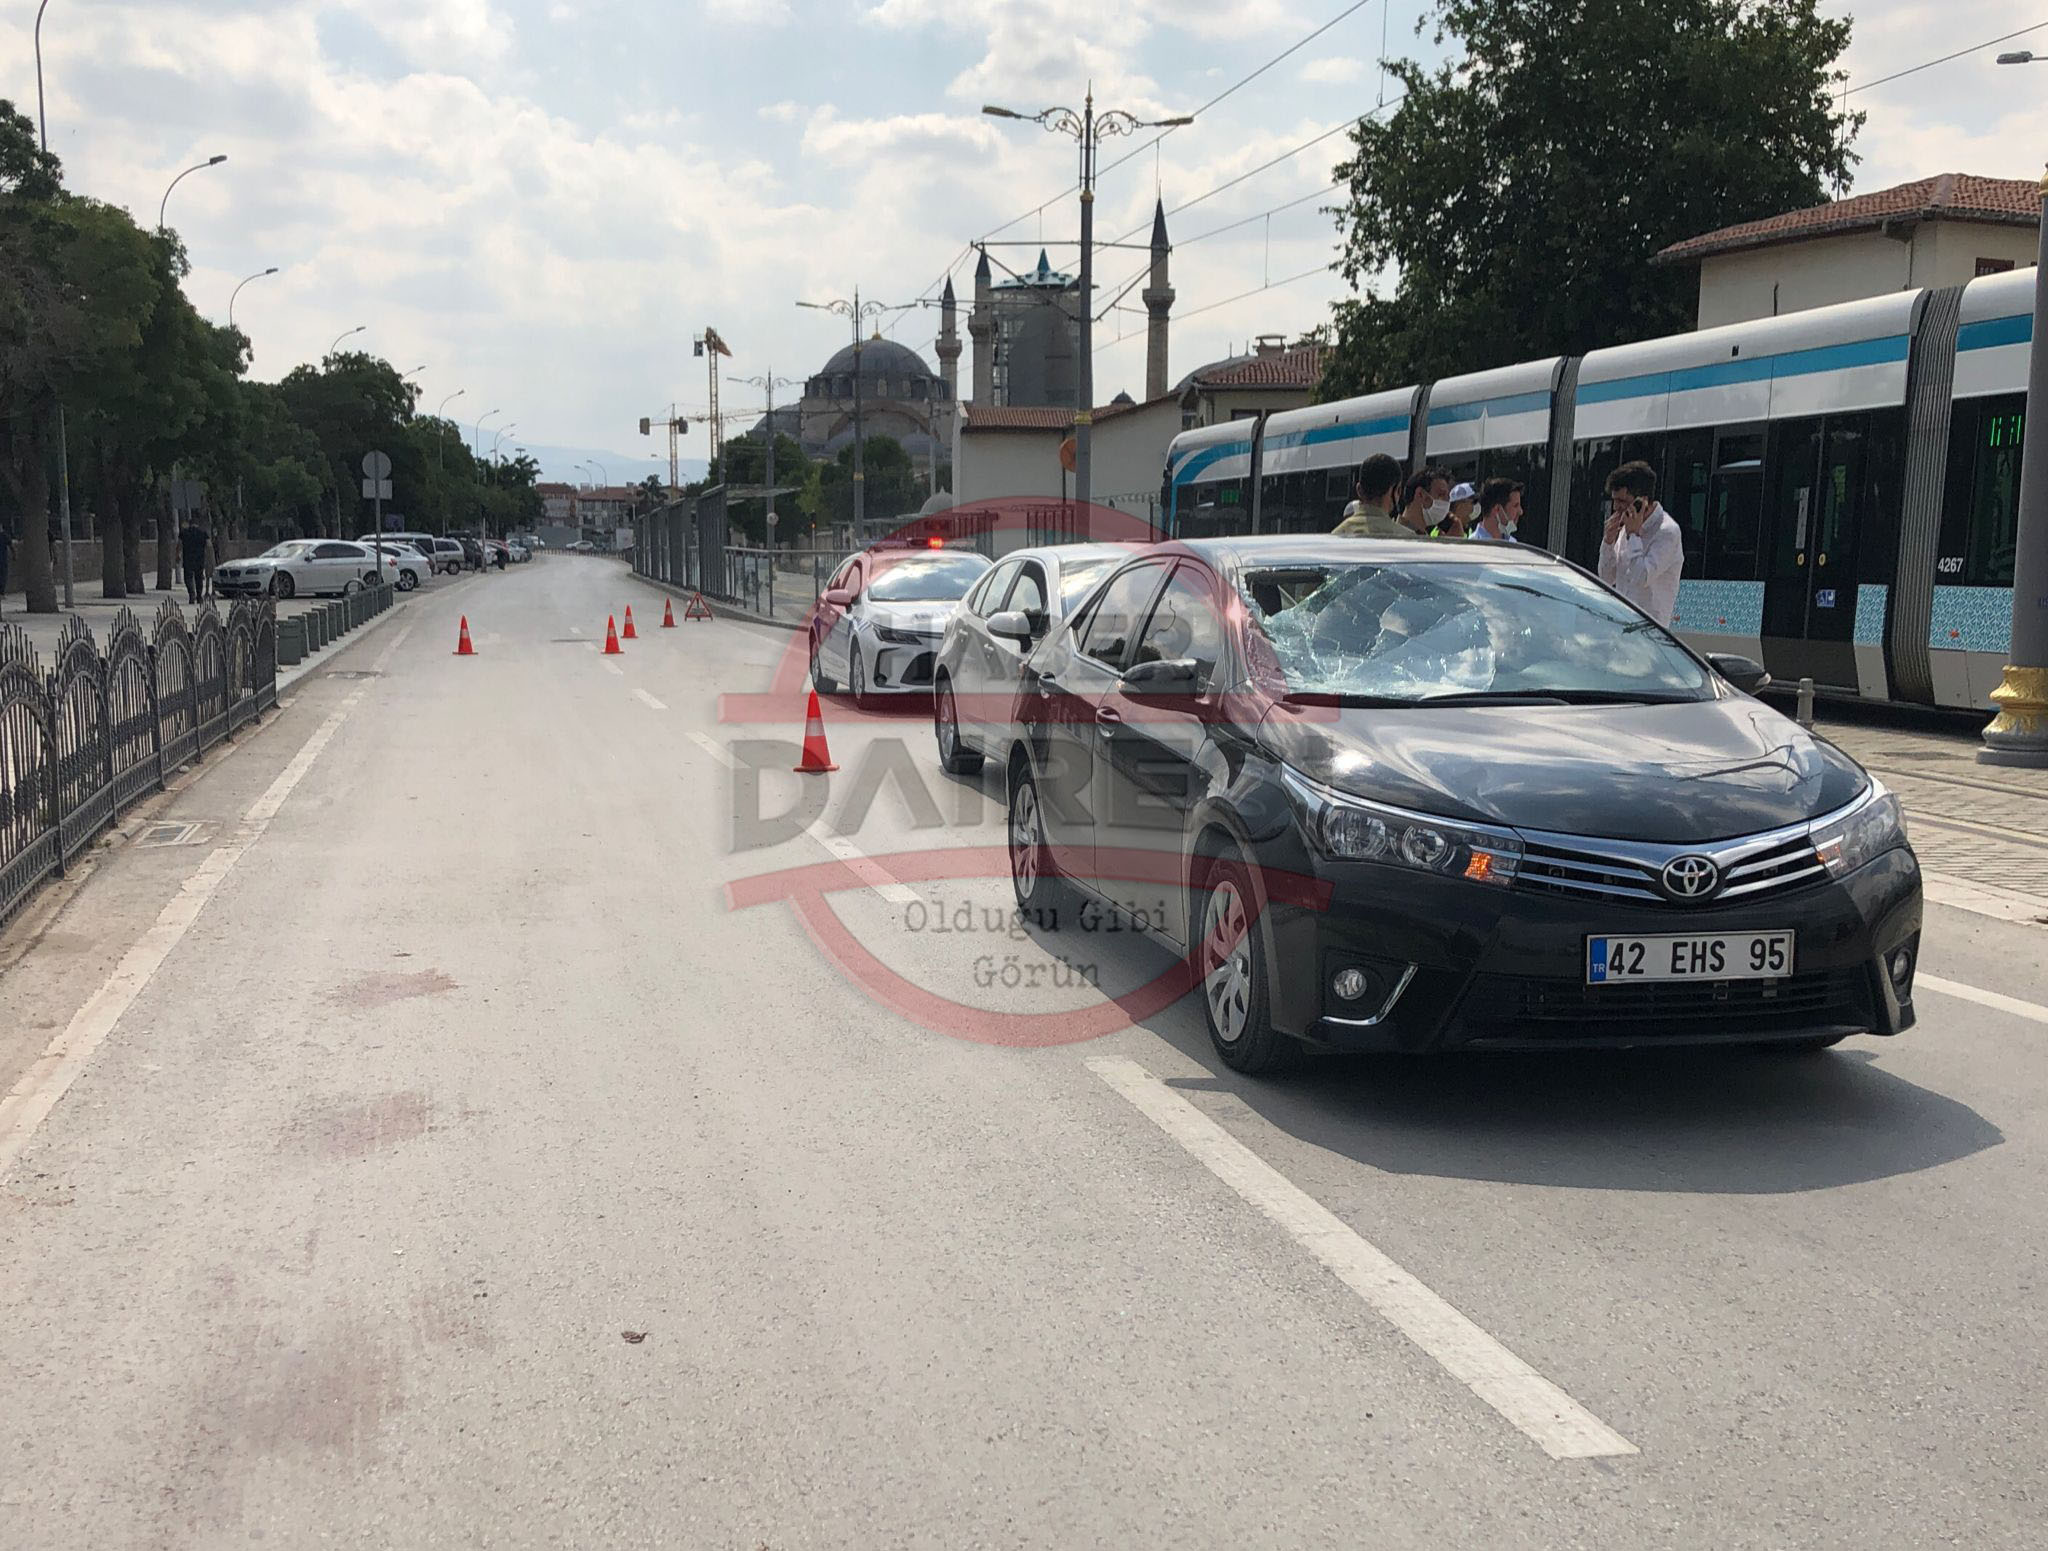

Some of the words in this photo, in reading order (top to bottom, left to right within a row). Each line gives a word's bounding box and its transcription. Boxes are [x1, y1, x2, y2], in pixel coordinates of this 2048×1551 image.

[1938, 557, 1964, 573] 4267
[1593, 963, 1605, 973] TR
[1608, 942, 1646, 975] 42
[1670, 940, 1726, 974] EHS
[1749, 937, 1786, 971] 95
